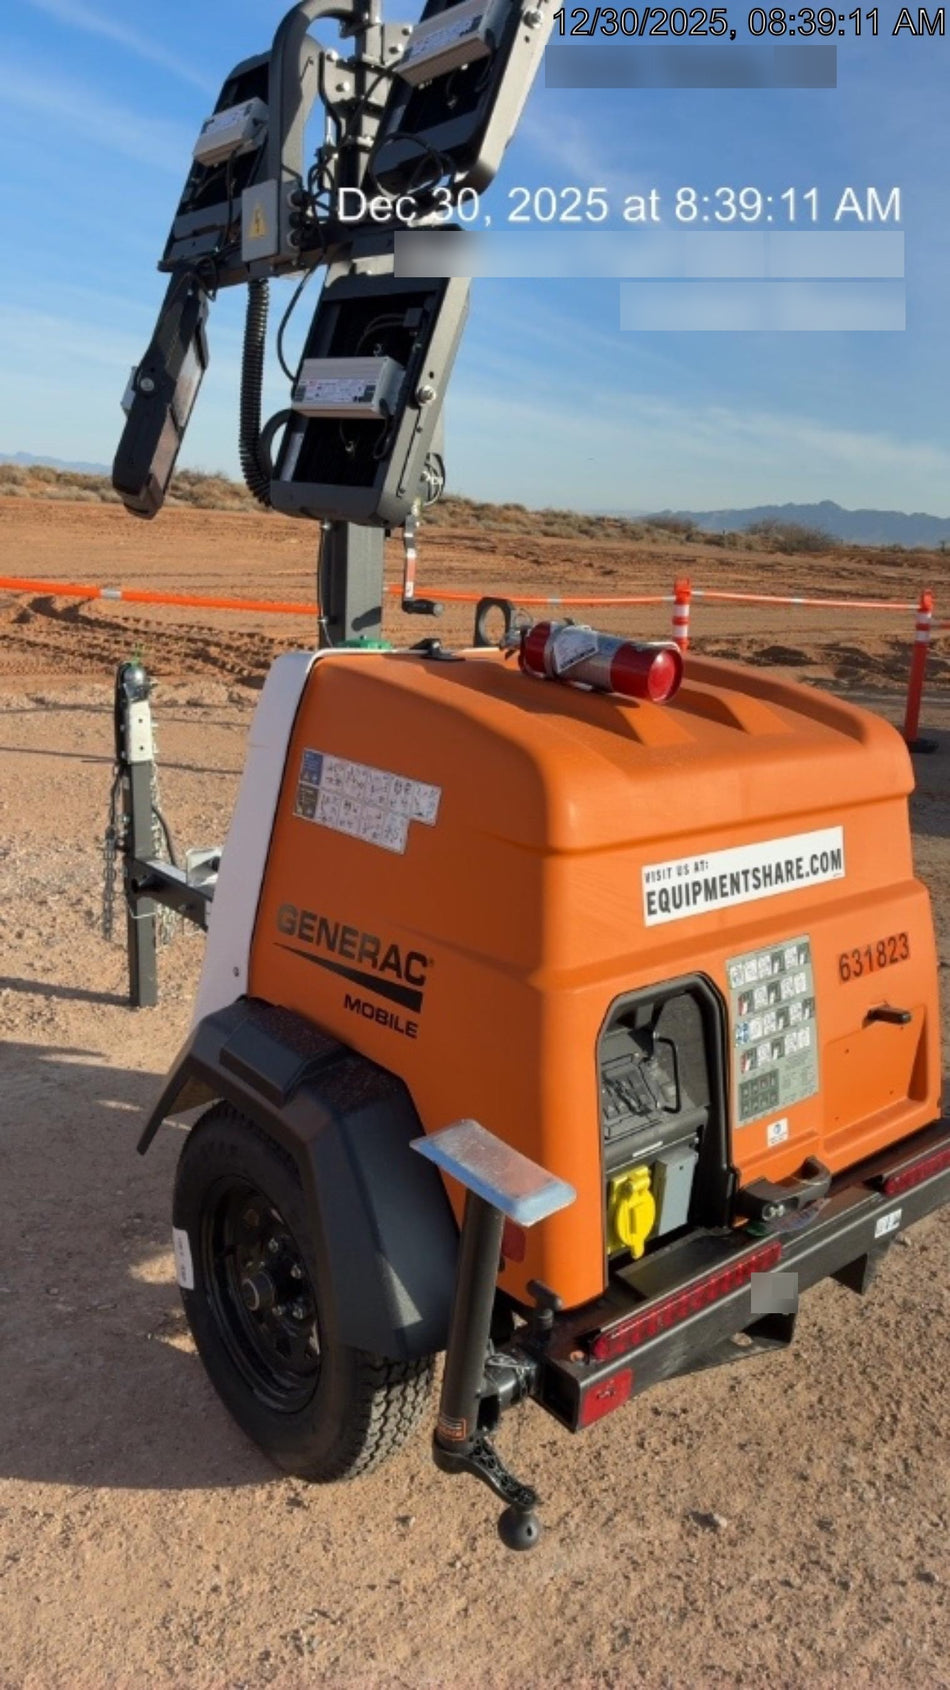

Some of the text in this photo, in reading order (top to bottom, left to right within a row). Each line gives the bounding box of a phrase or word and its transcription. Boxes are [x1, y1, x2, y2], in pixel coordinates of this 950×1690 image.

[645, 860, 709, 883] VISIT US AT:
[646, 848, 843, 916] EQUIPMENTSHARE.COM
[277, 903, 428, 986] GENERAC
[838, 932, 910, 982] 631823
[344, 994, 418, 1039] MOBILE
